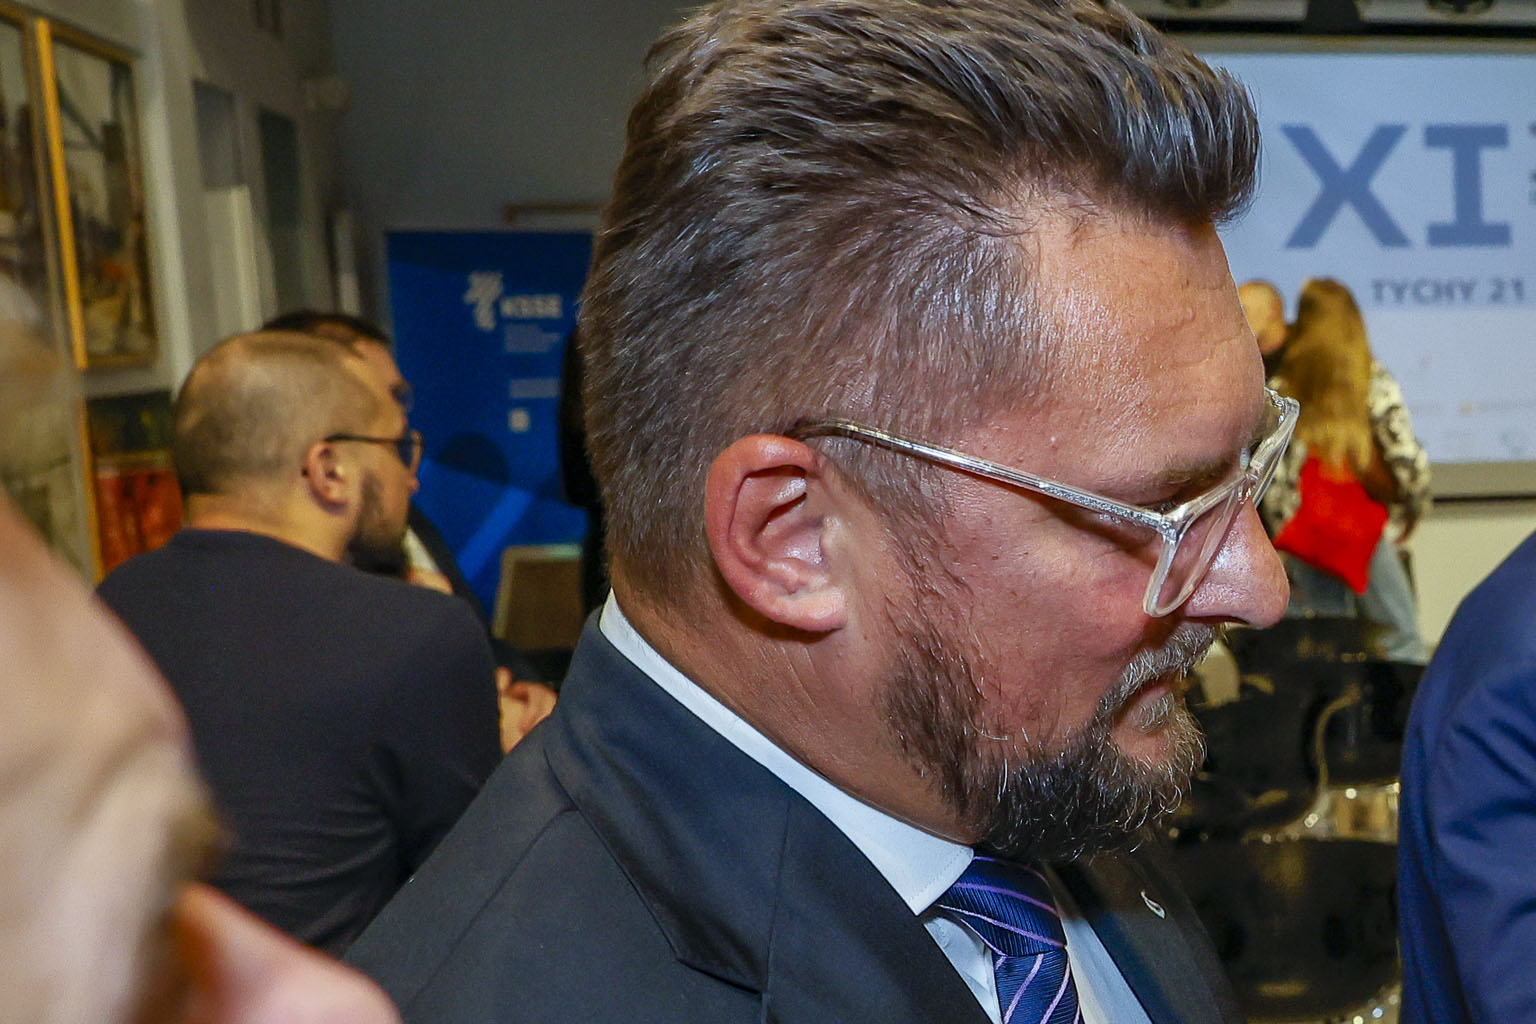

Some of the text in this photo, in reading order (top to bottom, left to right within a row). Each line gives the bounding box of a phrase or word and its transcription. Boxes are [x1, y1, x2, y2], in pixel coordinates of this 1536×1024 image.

[1281, 123, 1512, 248] XI
[1371, 278, 1477, 302] TYCHY
[1488, 277, 1524, 302] 21
